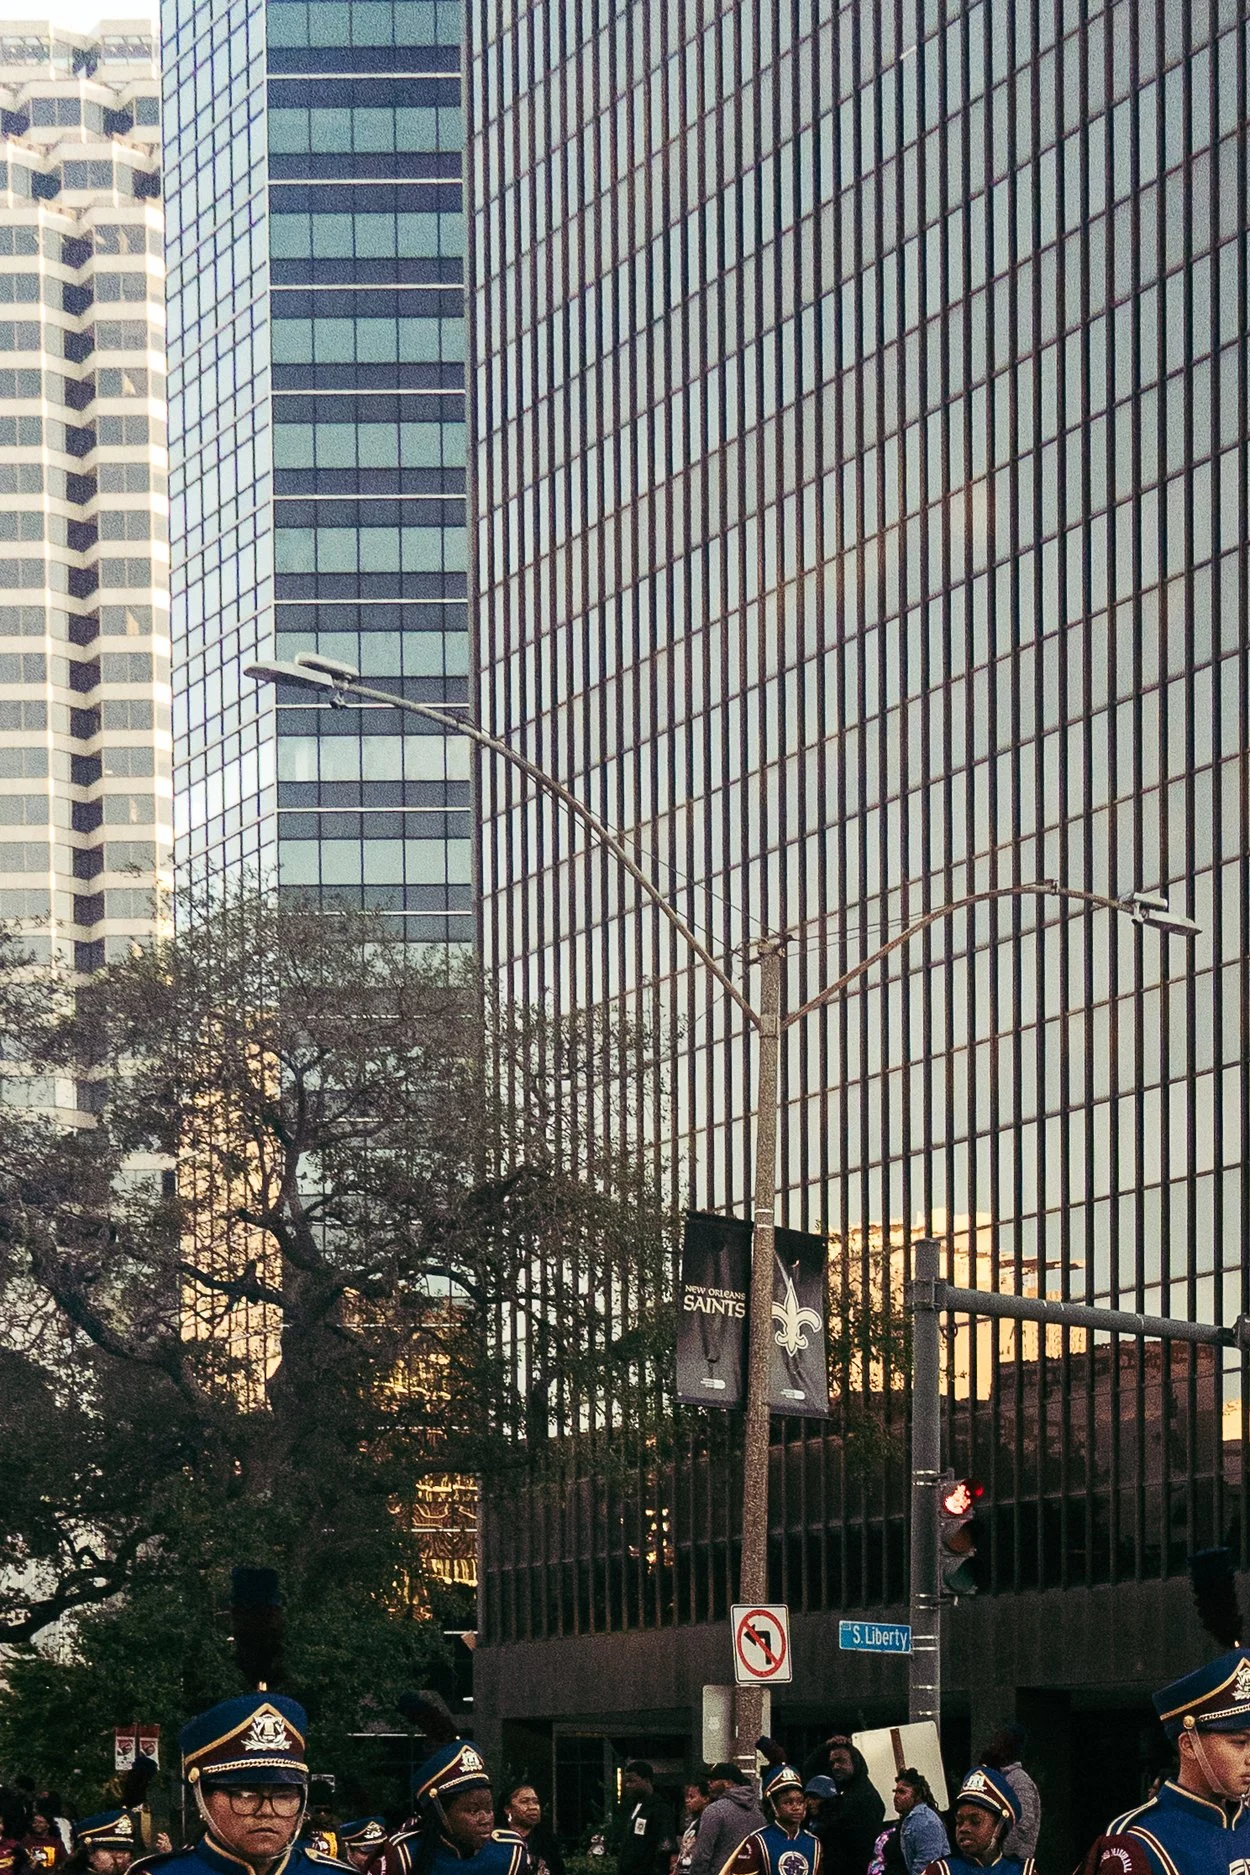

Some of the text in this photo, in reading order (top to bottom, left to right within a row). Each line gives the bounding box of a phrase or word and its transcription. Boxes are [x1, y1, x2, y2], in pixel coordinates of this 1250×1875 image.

[685, 1284, 746, 1300] NEW ORLEANS
[683, 1294, 746, 1318] SAINTS
[852, 1625, 908, 1651] S. Liberty
